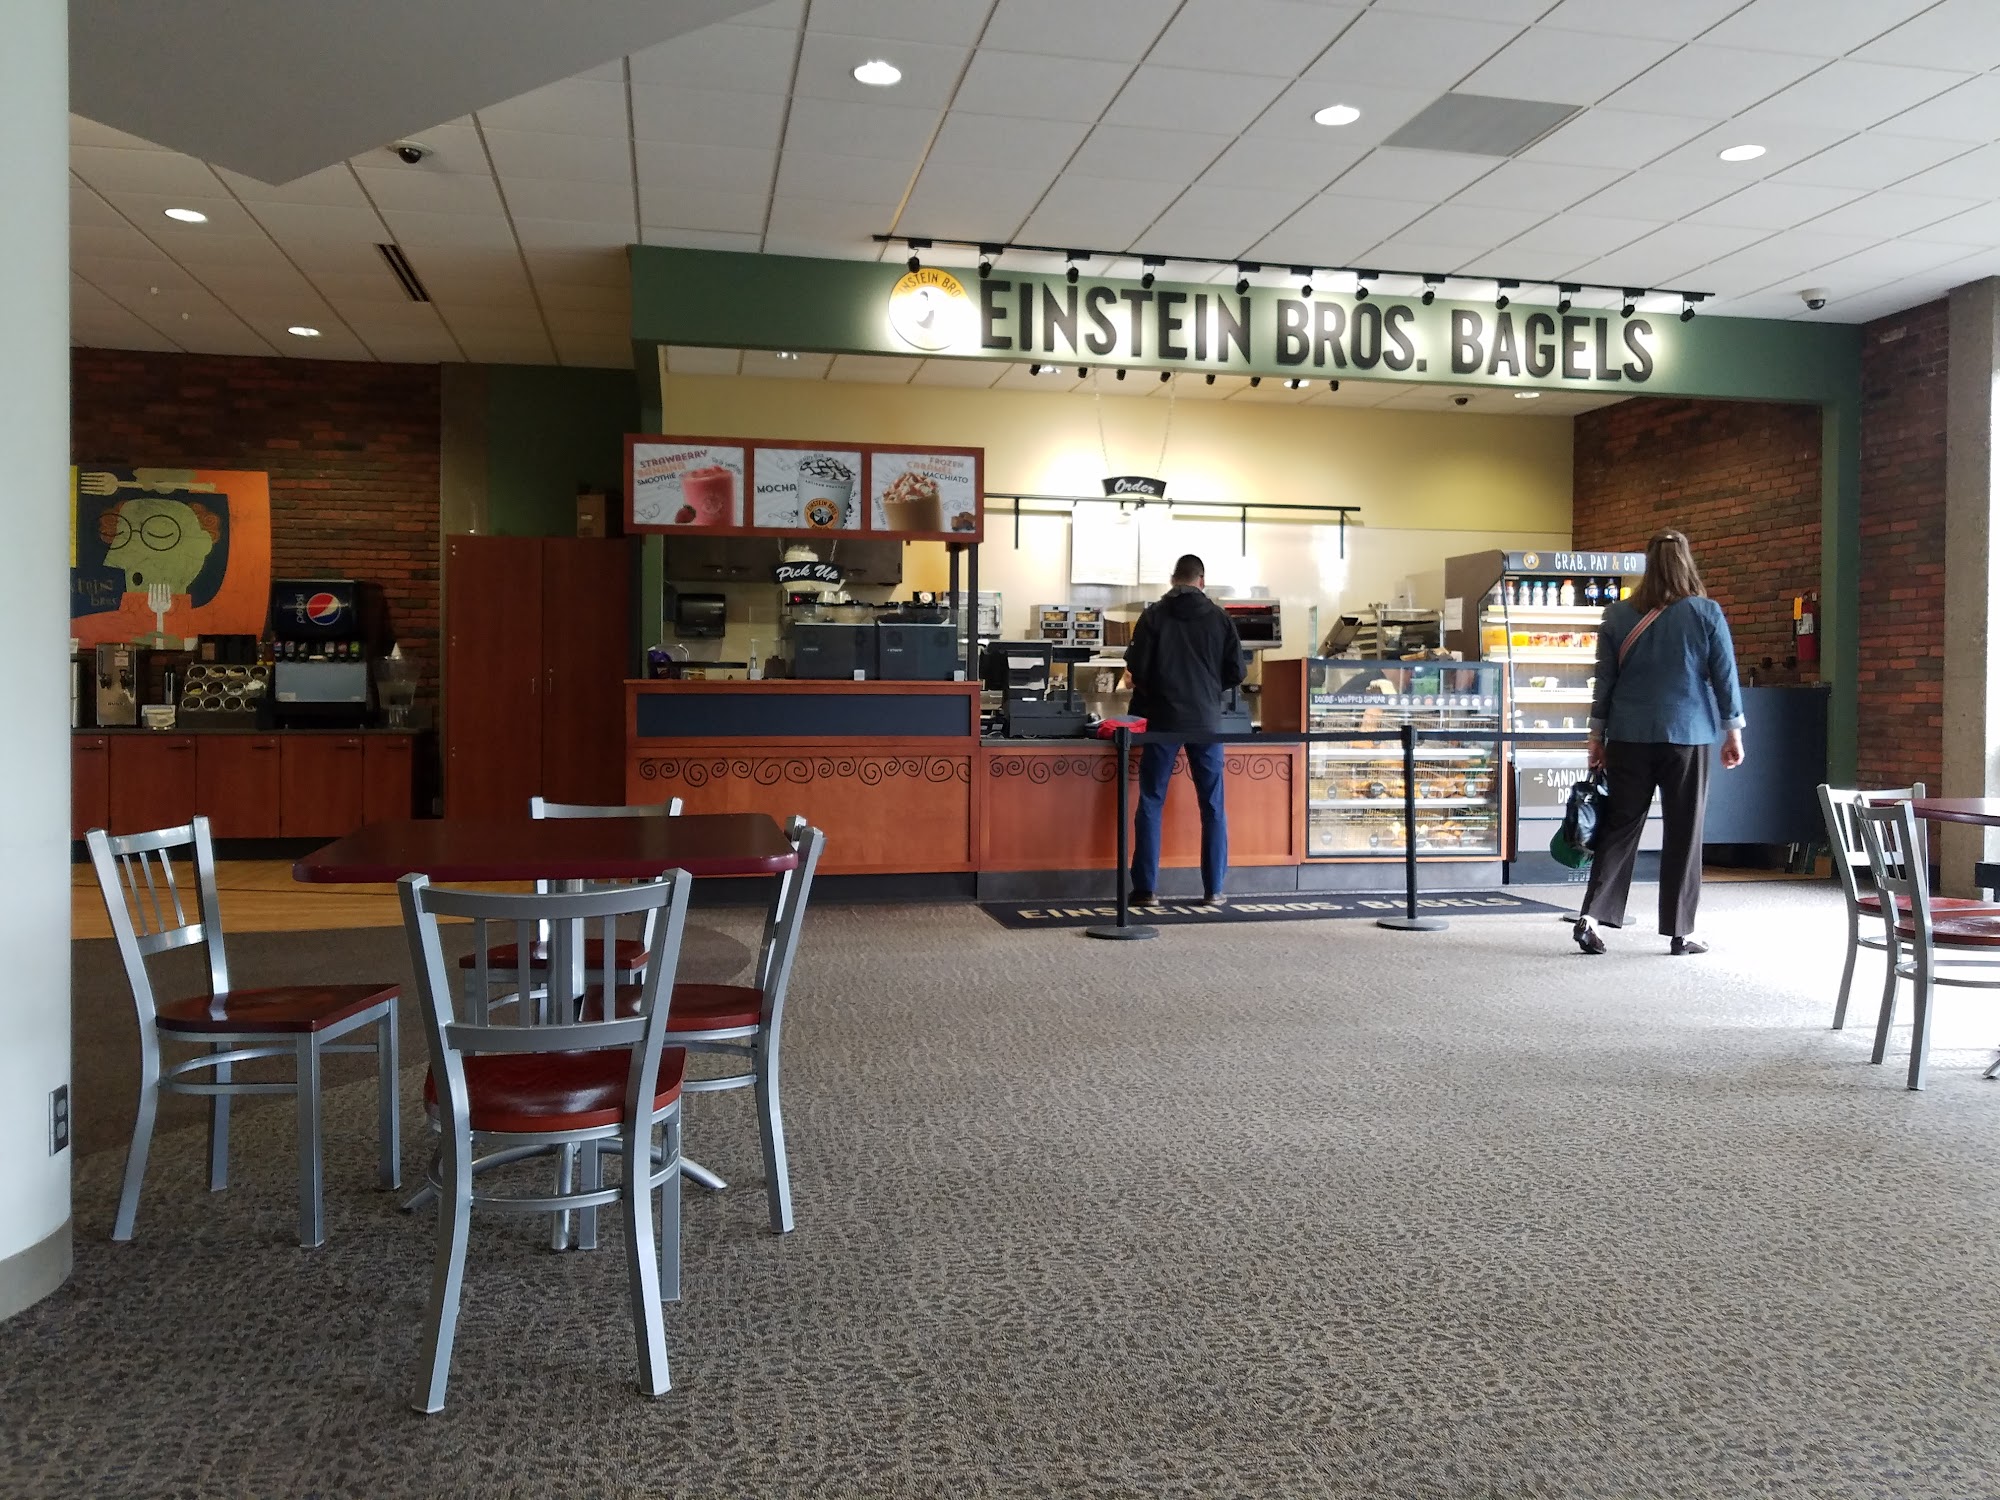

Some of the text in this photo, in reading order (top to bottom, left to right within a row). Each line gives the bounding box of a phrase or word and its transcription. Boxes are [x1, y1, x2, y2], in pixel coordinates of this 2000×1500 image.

[899, 272, 962, 298] INSTEIN BRO
[980, 280, 1653, 382] EINSTEIN BROS. BAGELS
[640, 449, 708, 468] STRAWBERRY
[929, 457, 964, 469] FROZEN
[637, 472, 676, 486] SMOOTHIE
[922, 471, 969, 484] MACCHIATO
[1114, 478, 1155, 494] Order
[757, 483, 797, 494] MOCHA
[1590, 554, 1608, 571] PAY
[1611, 556, 1620, 570] &
[1623, 555, 1637, 571] GO
[776, 564, 839, 582] Pick Up
[295, 593, 306, 624] pepsi
[1547, 768, 1594, 788] SANDW
[1016, 905, 1223, 919] EINSTEIN
